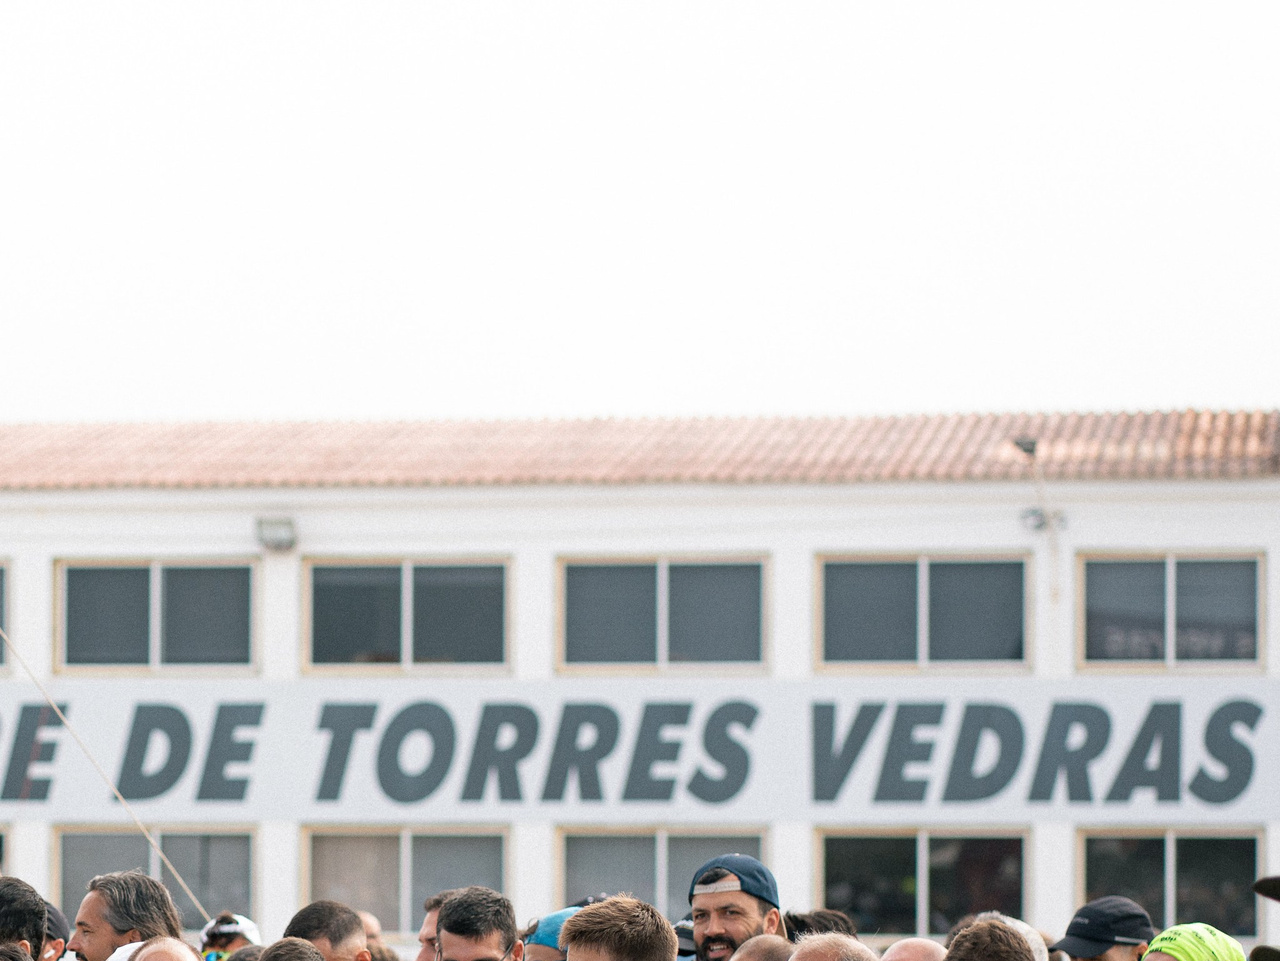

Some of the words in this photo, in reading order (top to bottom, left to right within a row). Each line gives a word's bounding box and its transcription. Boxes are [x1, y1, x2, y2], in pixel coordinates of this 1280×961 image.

[113, 702, 265, 802] DE
[314, 700, 761, 803] TORRES
[811, 698, 1264, 804] VEDRAS
